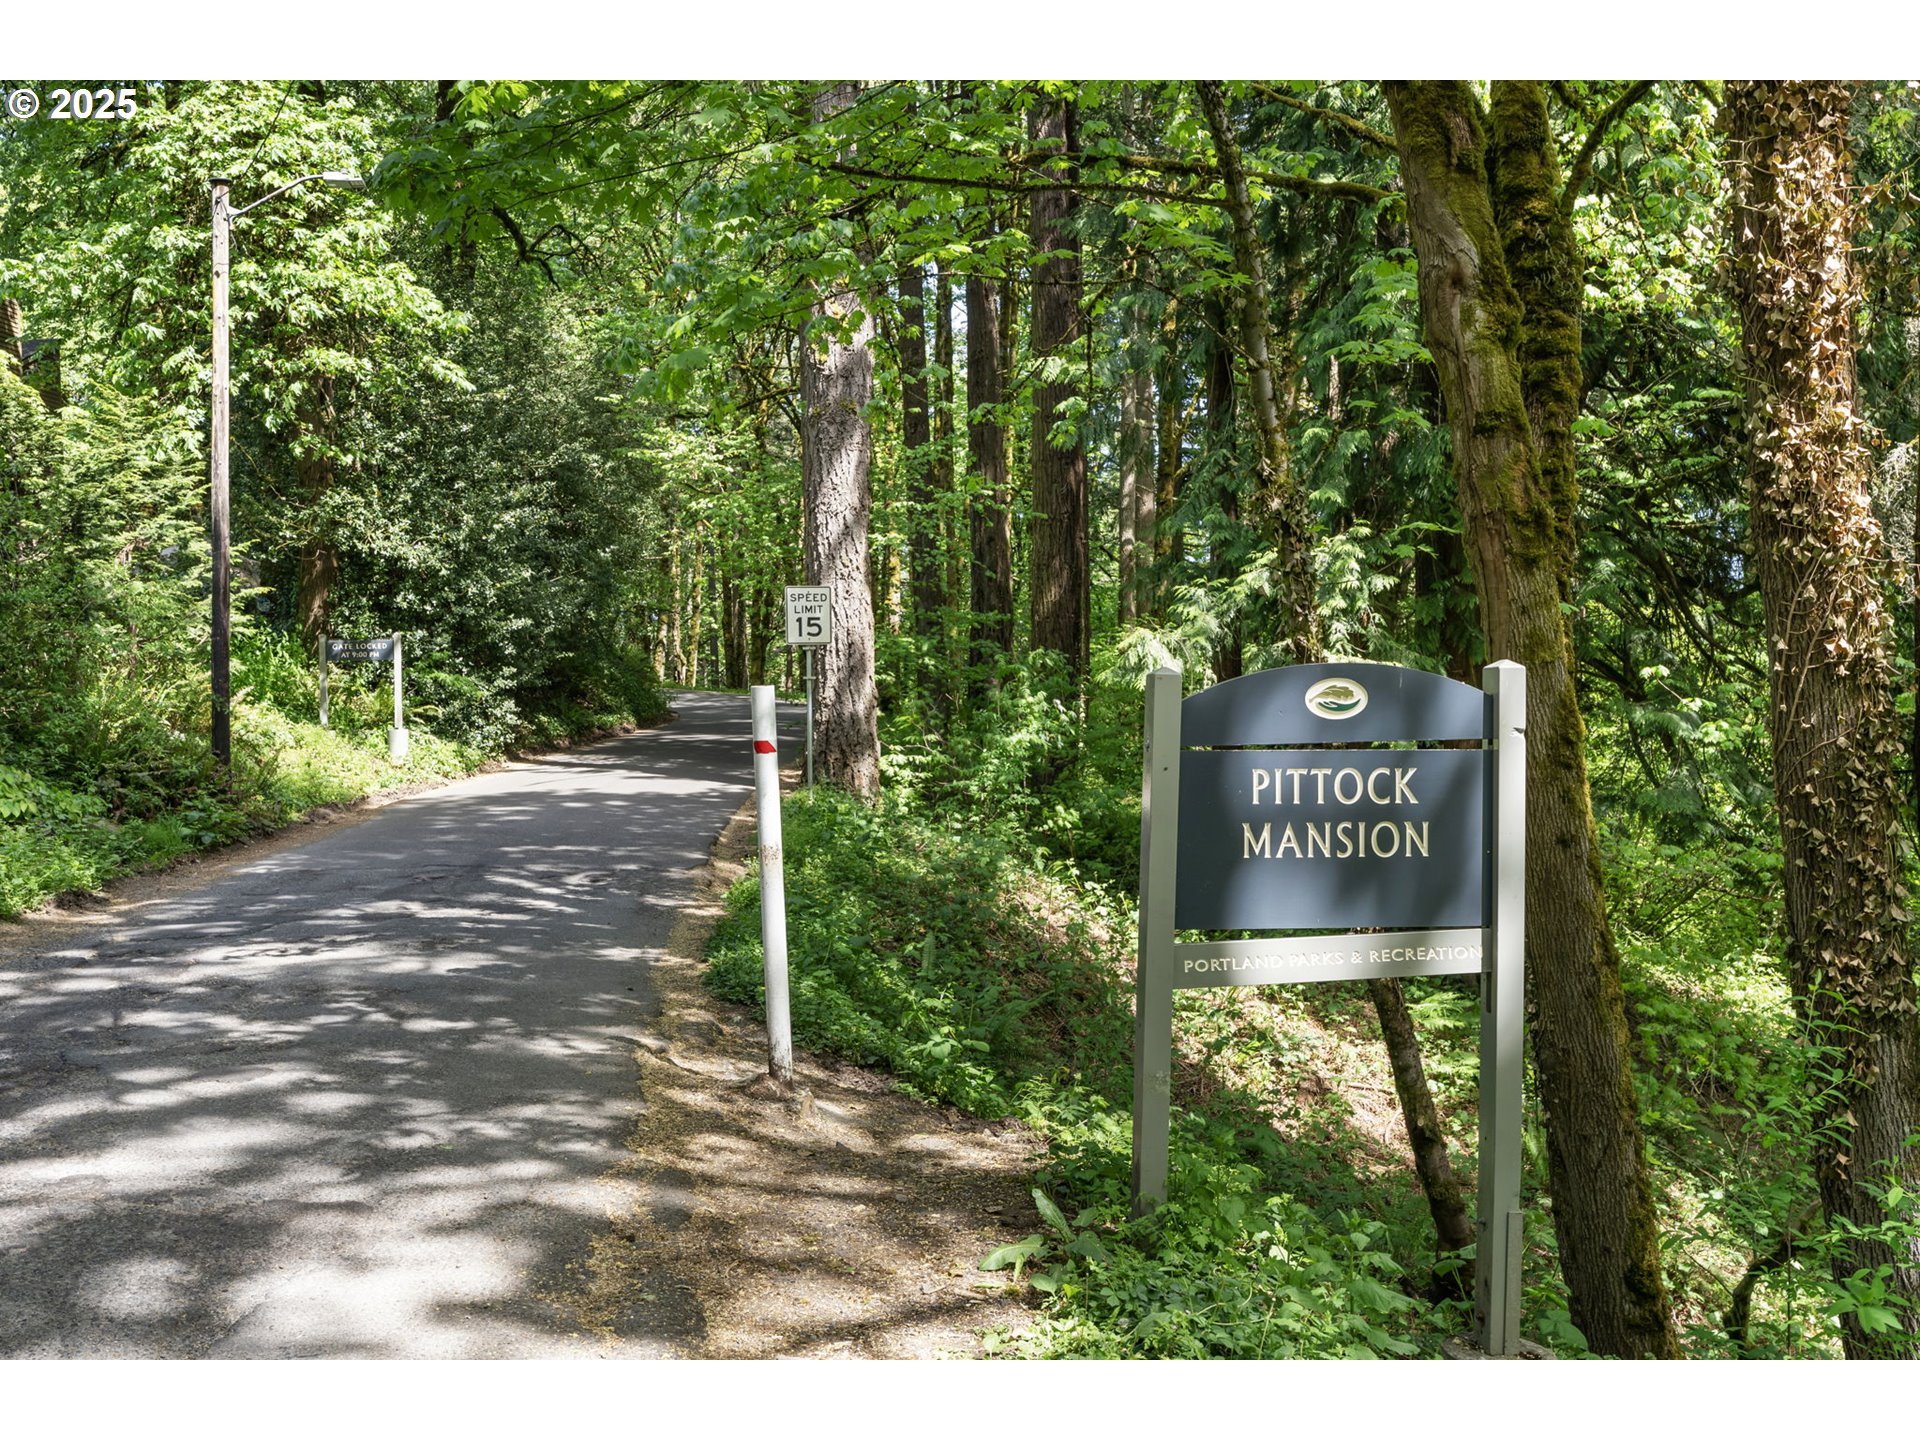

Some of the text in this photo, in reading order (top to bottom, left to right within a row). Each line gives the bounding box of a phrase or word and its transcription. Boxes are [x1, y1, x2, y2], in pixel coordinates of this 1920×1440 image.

[790, 593, 827, 602] SPEED
[794, 605, 823, 614] LIMIT
[796, 617, 822, 637] 15
[1251, 767, 1419, 805] PITTOCK
[1242, 821, 1430, 859] MANSION
[1184, 945, 1484, 973] PORTLAND PARKS & RECREATION
